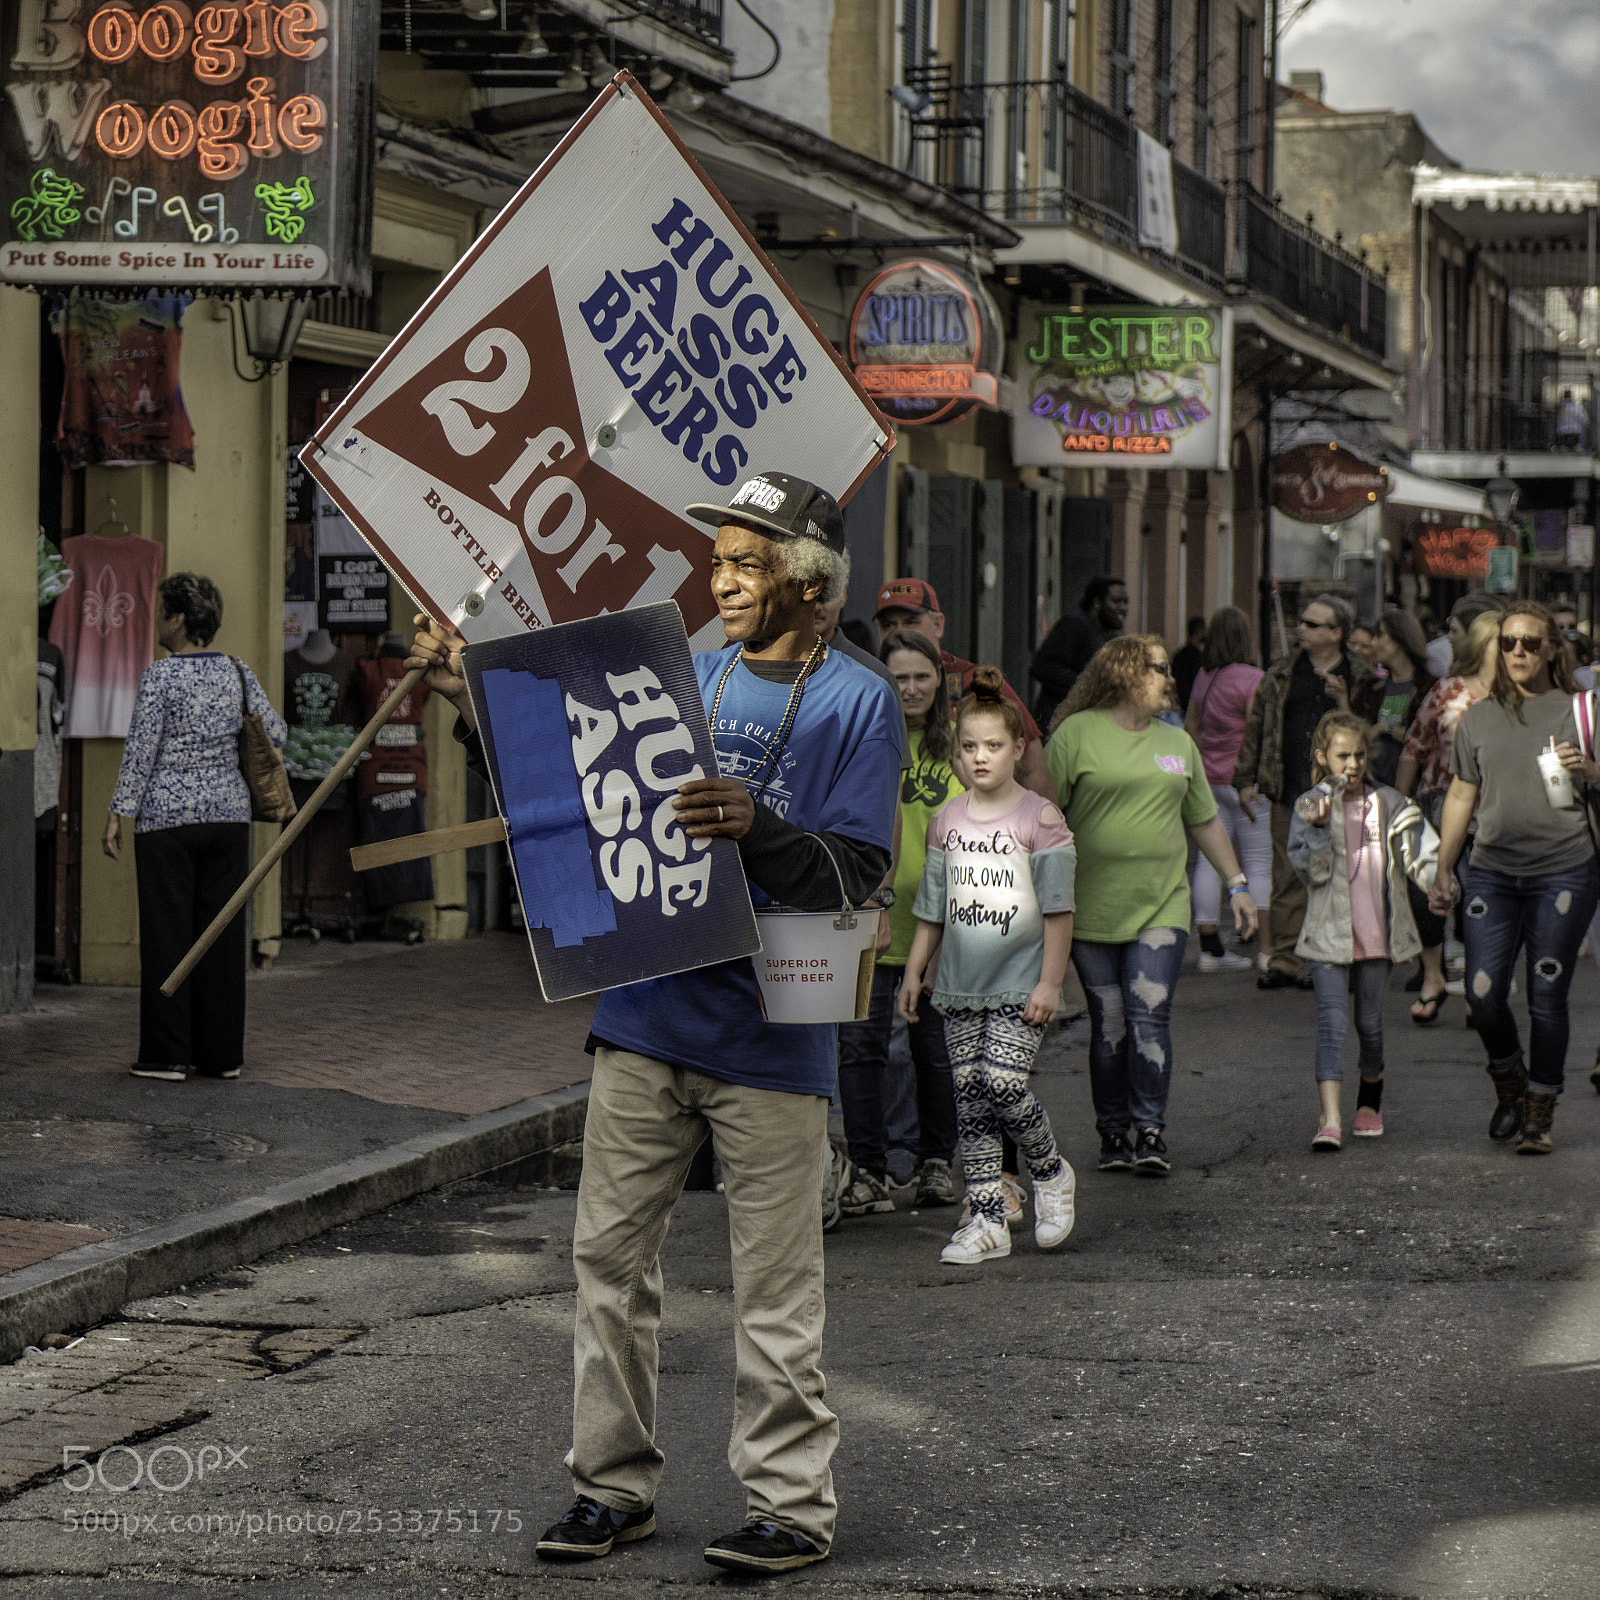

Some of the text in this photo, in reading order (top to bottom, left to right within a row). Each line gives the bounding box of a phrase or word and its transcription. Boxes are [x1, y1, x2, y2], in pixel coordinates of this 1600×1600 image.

[10, 0, 328, 85] Boogie
[5, 77, 328, 181] Woogie
[8, 251, 315, 272] Put Some Spice In Your Life
[651, 197, 808, 404] HUGE
[865, 294, 966, 346] SPIRITS
[620, 259, 768, 430] ASS
[1029, 315, 1213, 363] JESTER
[578, 269, 749, 487] BEERS
[861, 370, 972, 391] RESURRECTION
[1031, 393, 1208, 438] DAIQUIRIS
[1064, 434, 1112, 452] AND
[420, 327, 695, 616] 2 for 1
[422, 487, 545, 631] BOTTLE BEE
[565, 692, 653, 903] ASS
[605, 665, 711, 916] HUGE
[943, 828, 1017, 855] Create
[949, 865, 1014, 888] YOUR OWN
[949, 897, 1019, 936] Destiny
[764, 972, 834, 983] LIGHT BEER
[766, 958, 829, 968] SUPERIOR
